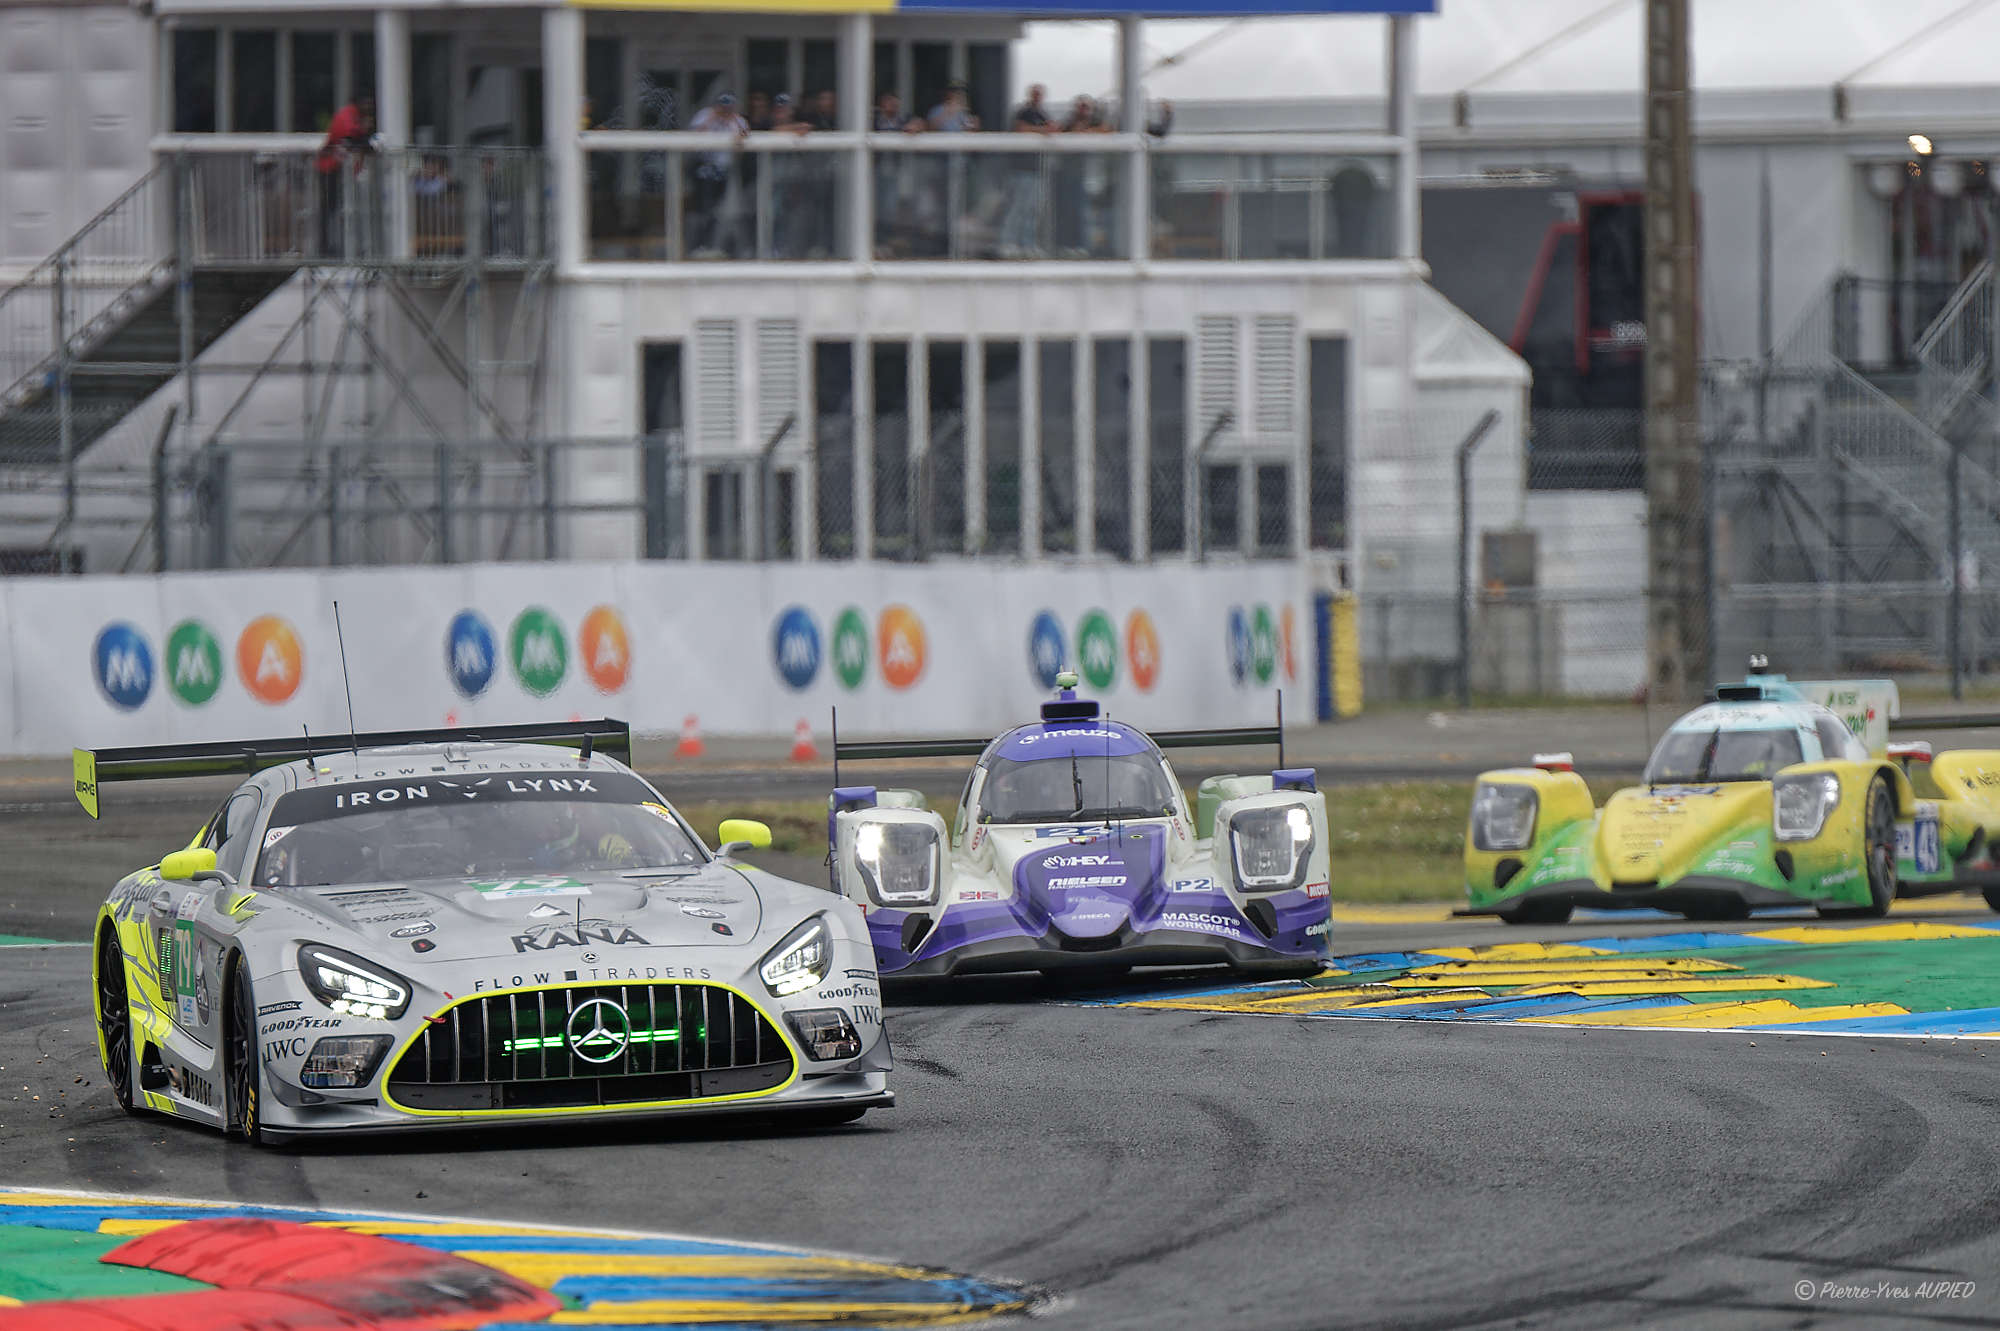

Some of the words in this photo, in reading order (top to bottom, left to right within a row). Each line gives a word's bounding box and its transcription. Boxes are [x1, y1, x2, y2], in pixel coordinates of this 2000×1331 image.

[334, 768, 414, 783] FLOW
[458, 761, 588, 771] TRADER
[336, 785, 429, 808] IRON
[507, 778, 598, 793] LYNX
[1048, 826, 1115, 837] 24
[1048, 876, 1127, 888] NIELSEN
[1175, 879, 1211, 891] P2
[1163, 920, 1241, 938] WORKWEAR
[511, 928, 651, 954] RANA
[176, 929, 192, 989] 79
[474, 972, 550, 992] FLOW
[591, 967, 712, 980] TRADERS
[261, 1015, 342, 1035] GOODYEAR
[265, 1037, 307, 1063] IWC
